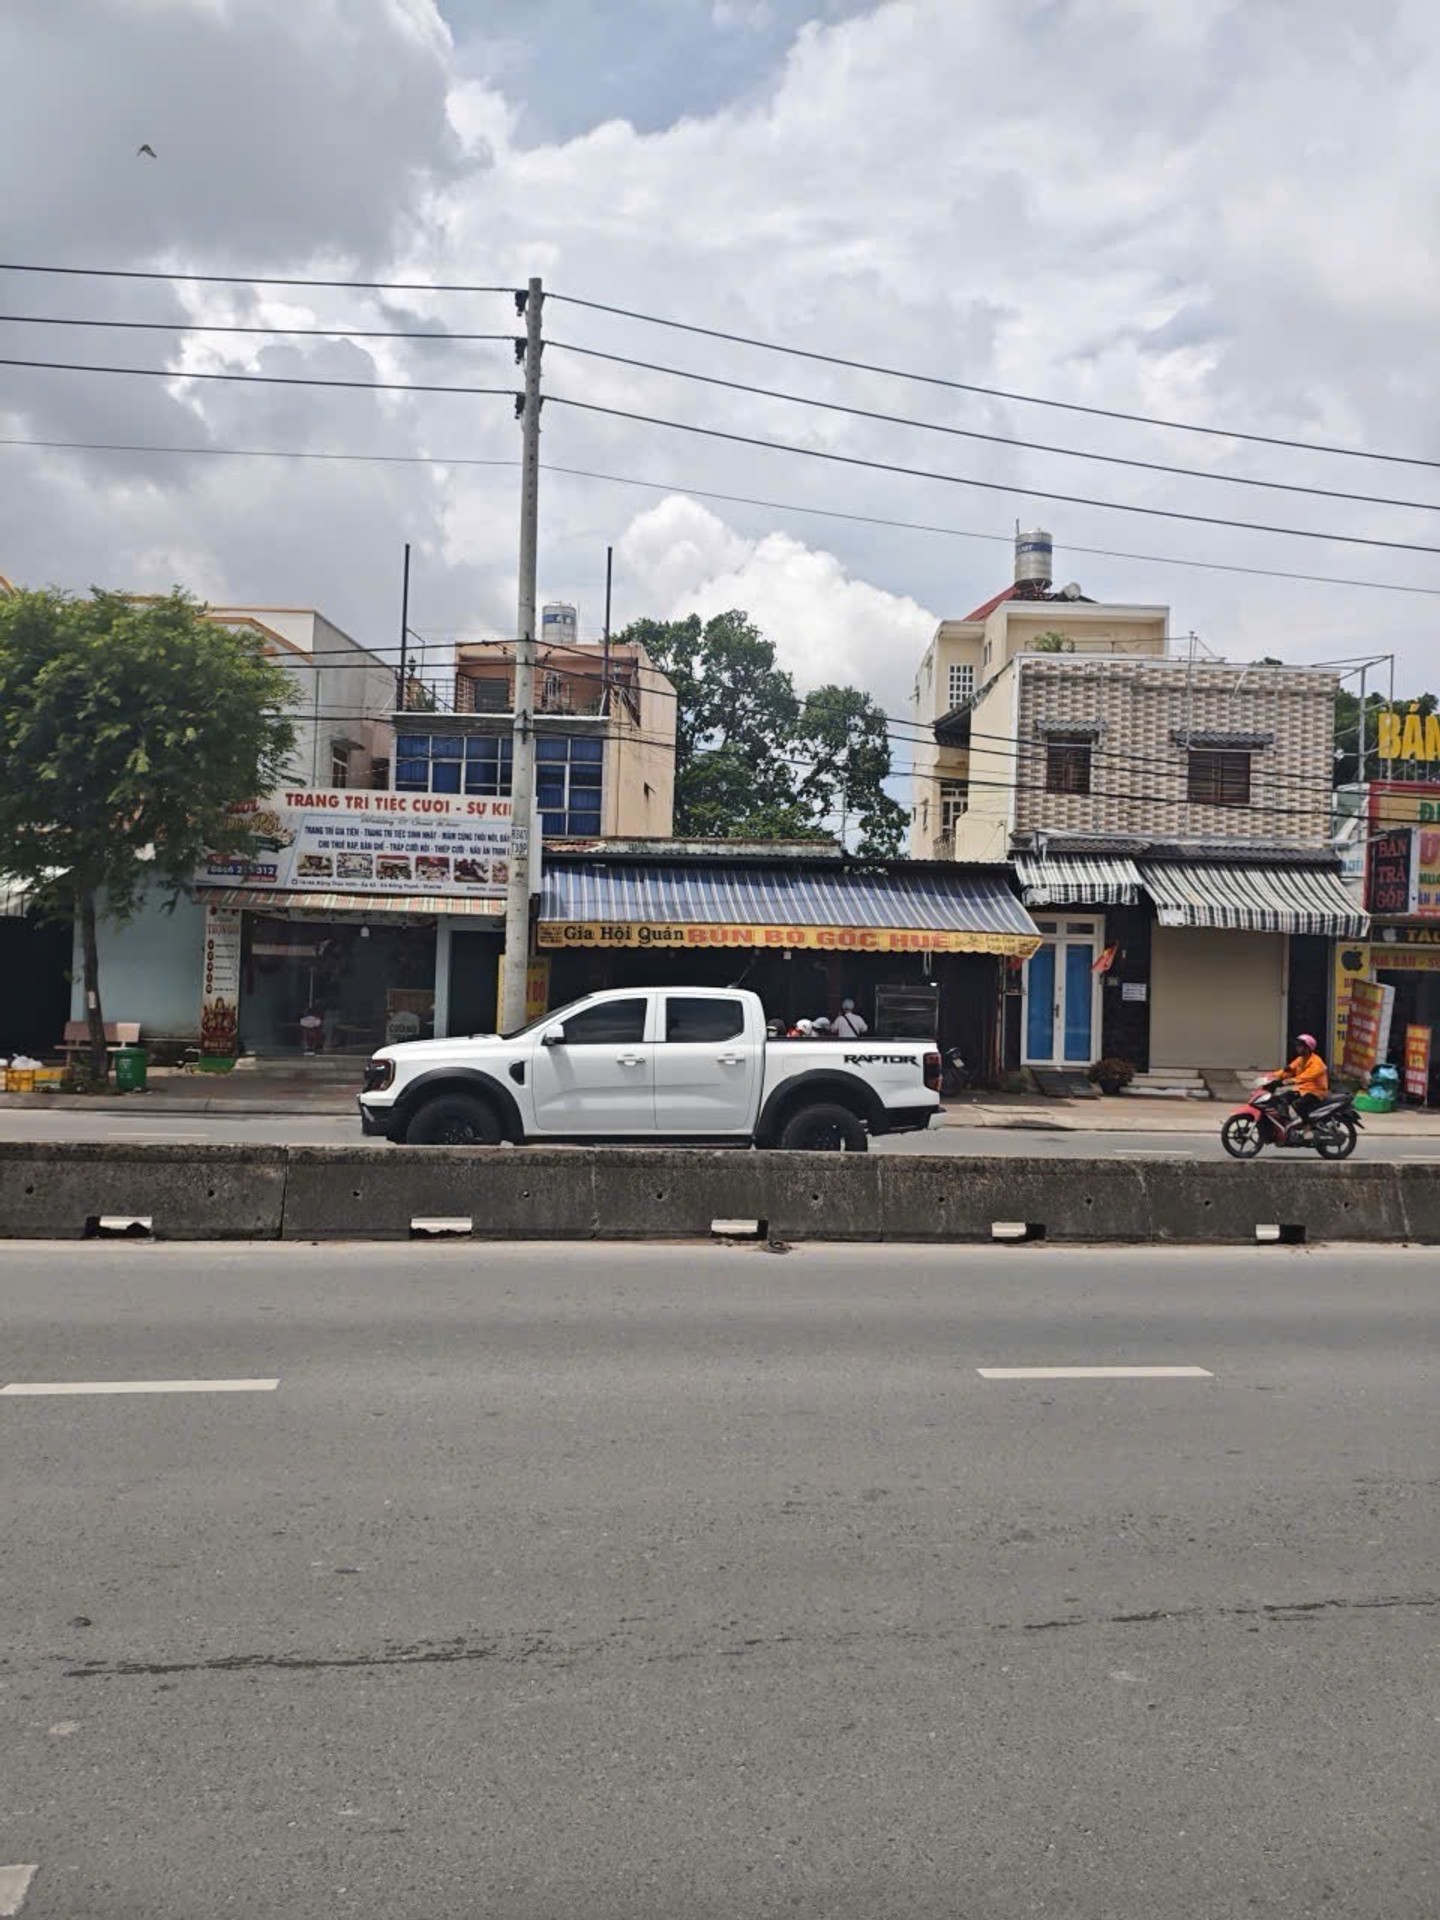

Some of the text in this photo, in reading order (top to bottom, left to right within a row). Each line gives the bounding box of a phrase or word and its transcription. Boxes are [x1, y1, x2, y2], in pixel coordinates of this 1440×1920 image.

[1378, 699, 1440, 762] BÁN
[285, 793, 340, 809] TRANG
[345, 794, 369, 810] TRÍ
[375, 795, 406, 814] TIỆC
[564, 925, 593, 940] Gia
[600, 926, 631, 943] Hội
[638, 926, 684, 945] Quán
[843, 1054, 921, 1069] RAPTOR
